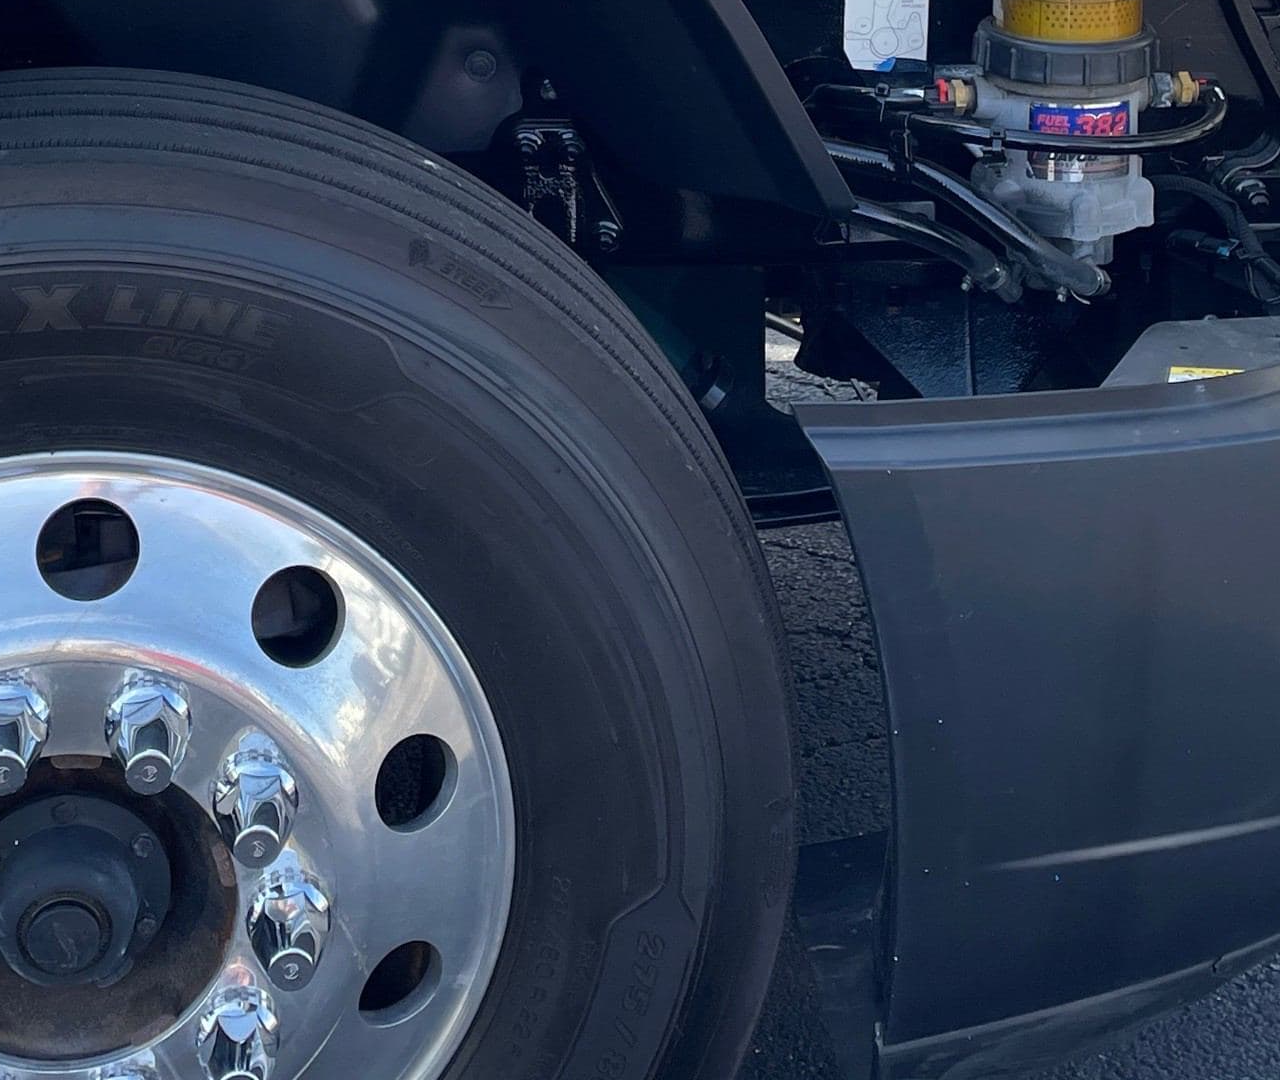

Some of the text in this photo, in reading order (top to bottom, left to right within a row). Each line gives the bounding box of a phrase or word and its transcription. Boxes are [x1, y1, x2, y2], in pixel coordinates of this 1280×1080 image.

[1037, 111, 1128, 136] FUEL 382
[11, 282, 293, 351] X LINE
[590, 930, 668, 1080] 275/8
